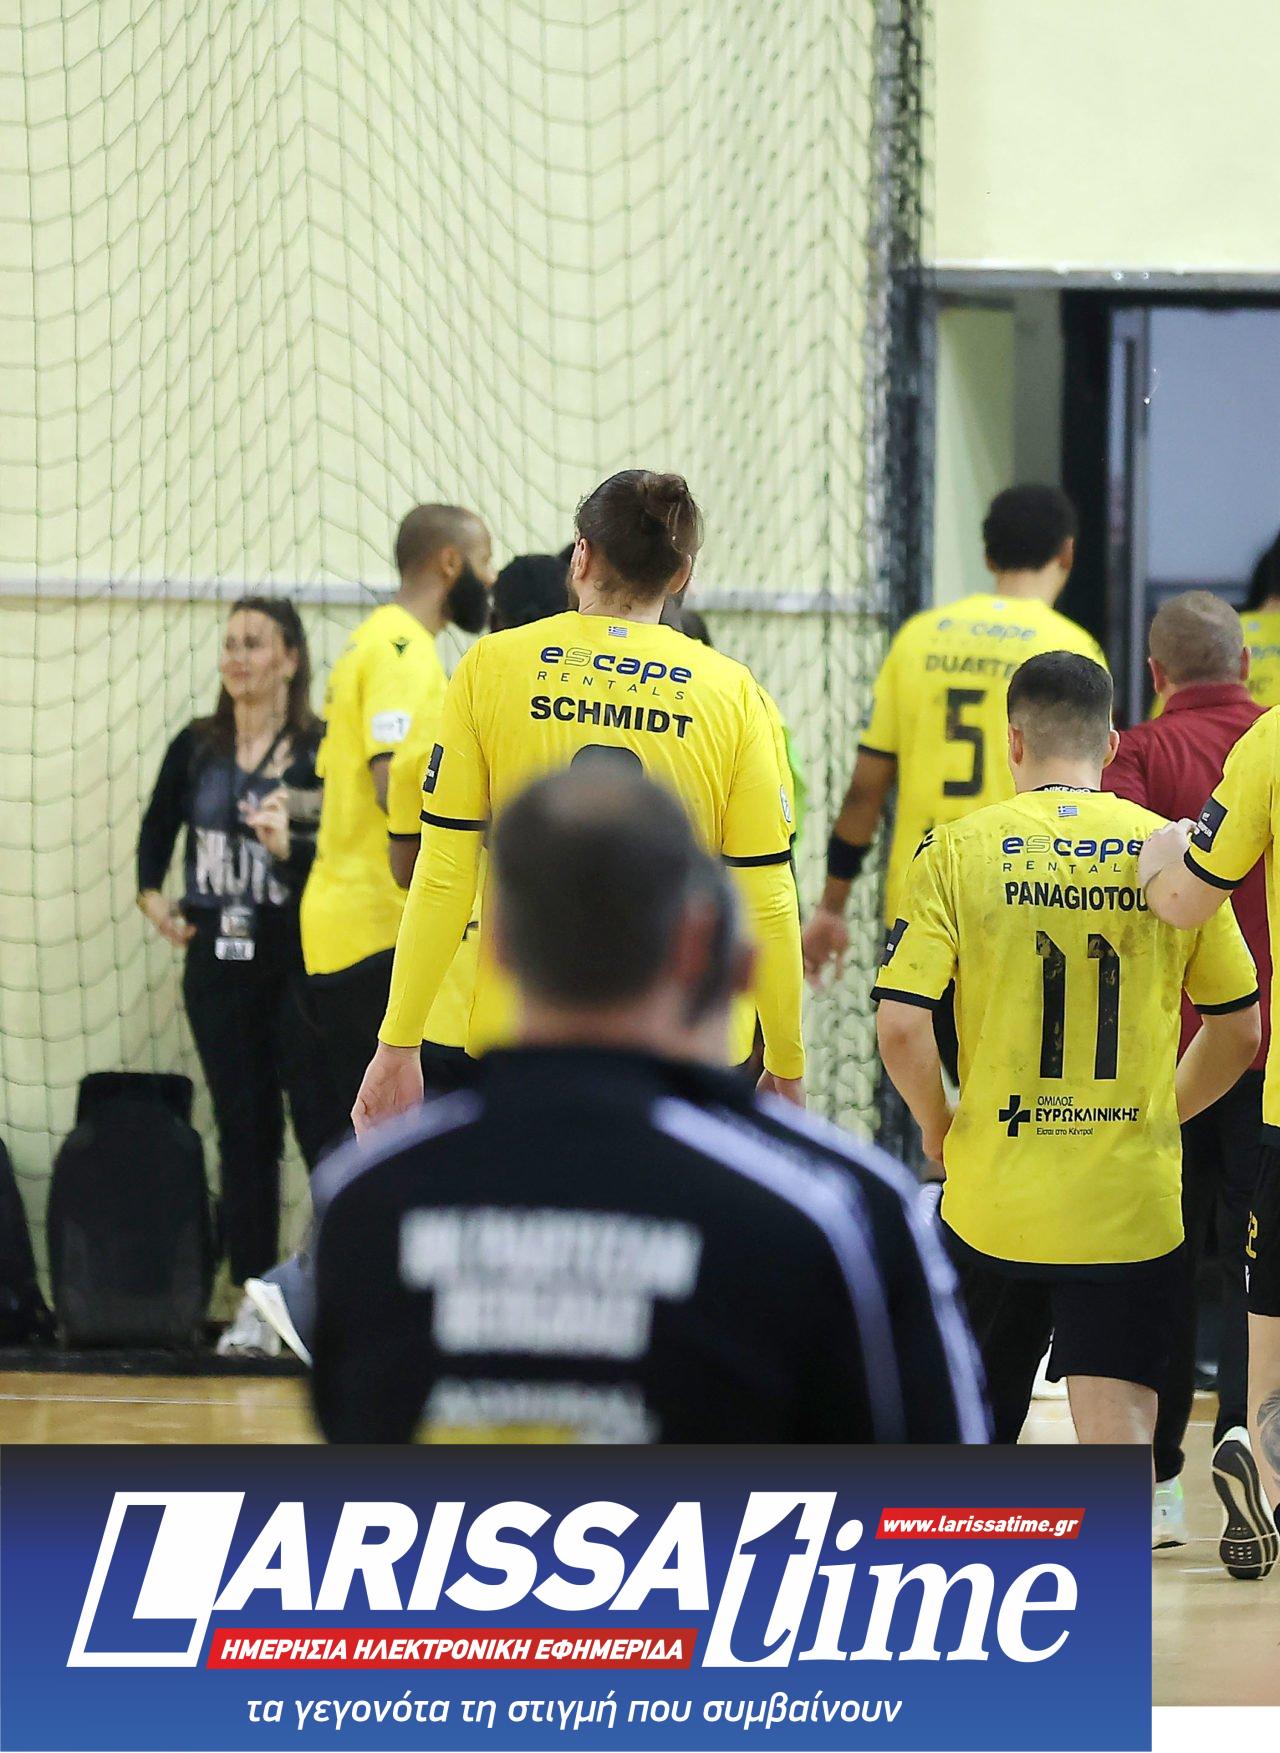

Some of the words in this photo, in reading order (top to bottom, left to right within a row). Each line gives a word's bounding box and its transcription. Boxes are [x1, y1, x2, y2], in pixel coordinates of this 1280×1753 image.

[540, 646, 692, 684] escape
[537, 671, 686, 700] RENTALS
[531, 695, 693, 738] SCHMIDT
[943, 687, 986, 796] 5
[1003, 861, 1139, 874] RENTAL
[1005, 881, 1149, 912] PANAGIOTOU
[1036, 931, 1121, 1080] 11
[1035, 1108, 1140, 1122] ΕΥΡΩΚΛΙΝΙΚΗΣ
[1037, 1096, 1074, 1107] ΟΜΙΛΟΣ
